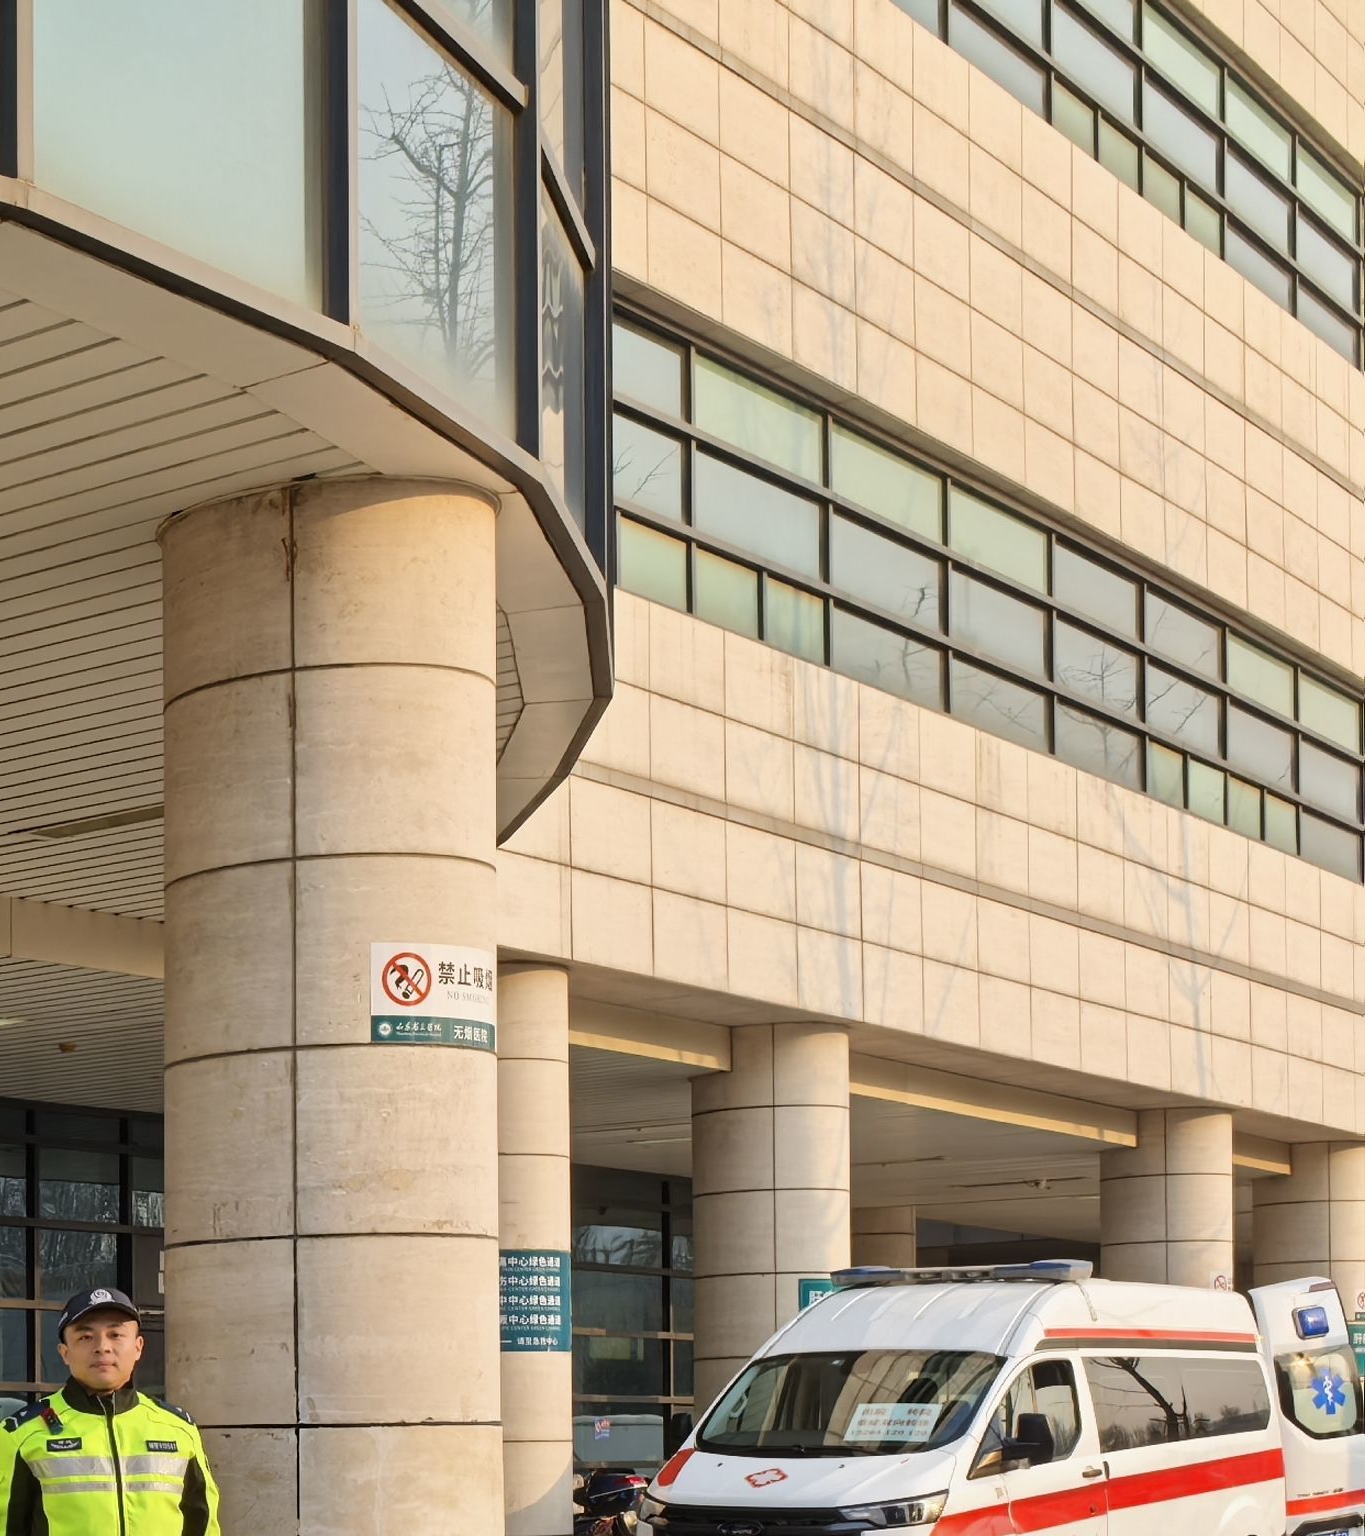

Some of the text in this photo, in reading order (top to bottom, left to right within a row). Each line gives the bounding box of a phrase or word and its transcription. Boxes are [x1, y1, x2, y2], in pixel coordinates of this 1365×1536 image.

[438, 961, 493, 992] 禁止吸烟
[453, 1025, 489, 1043] 无烟医院
